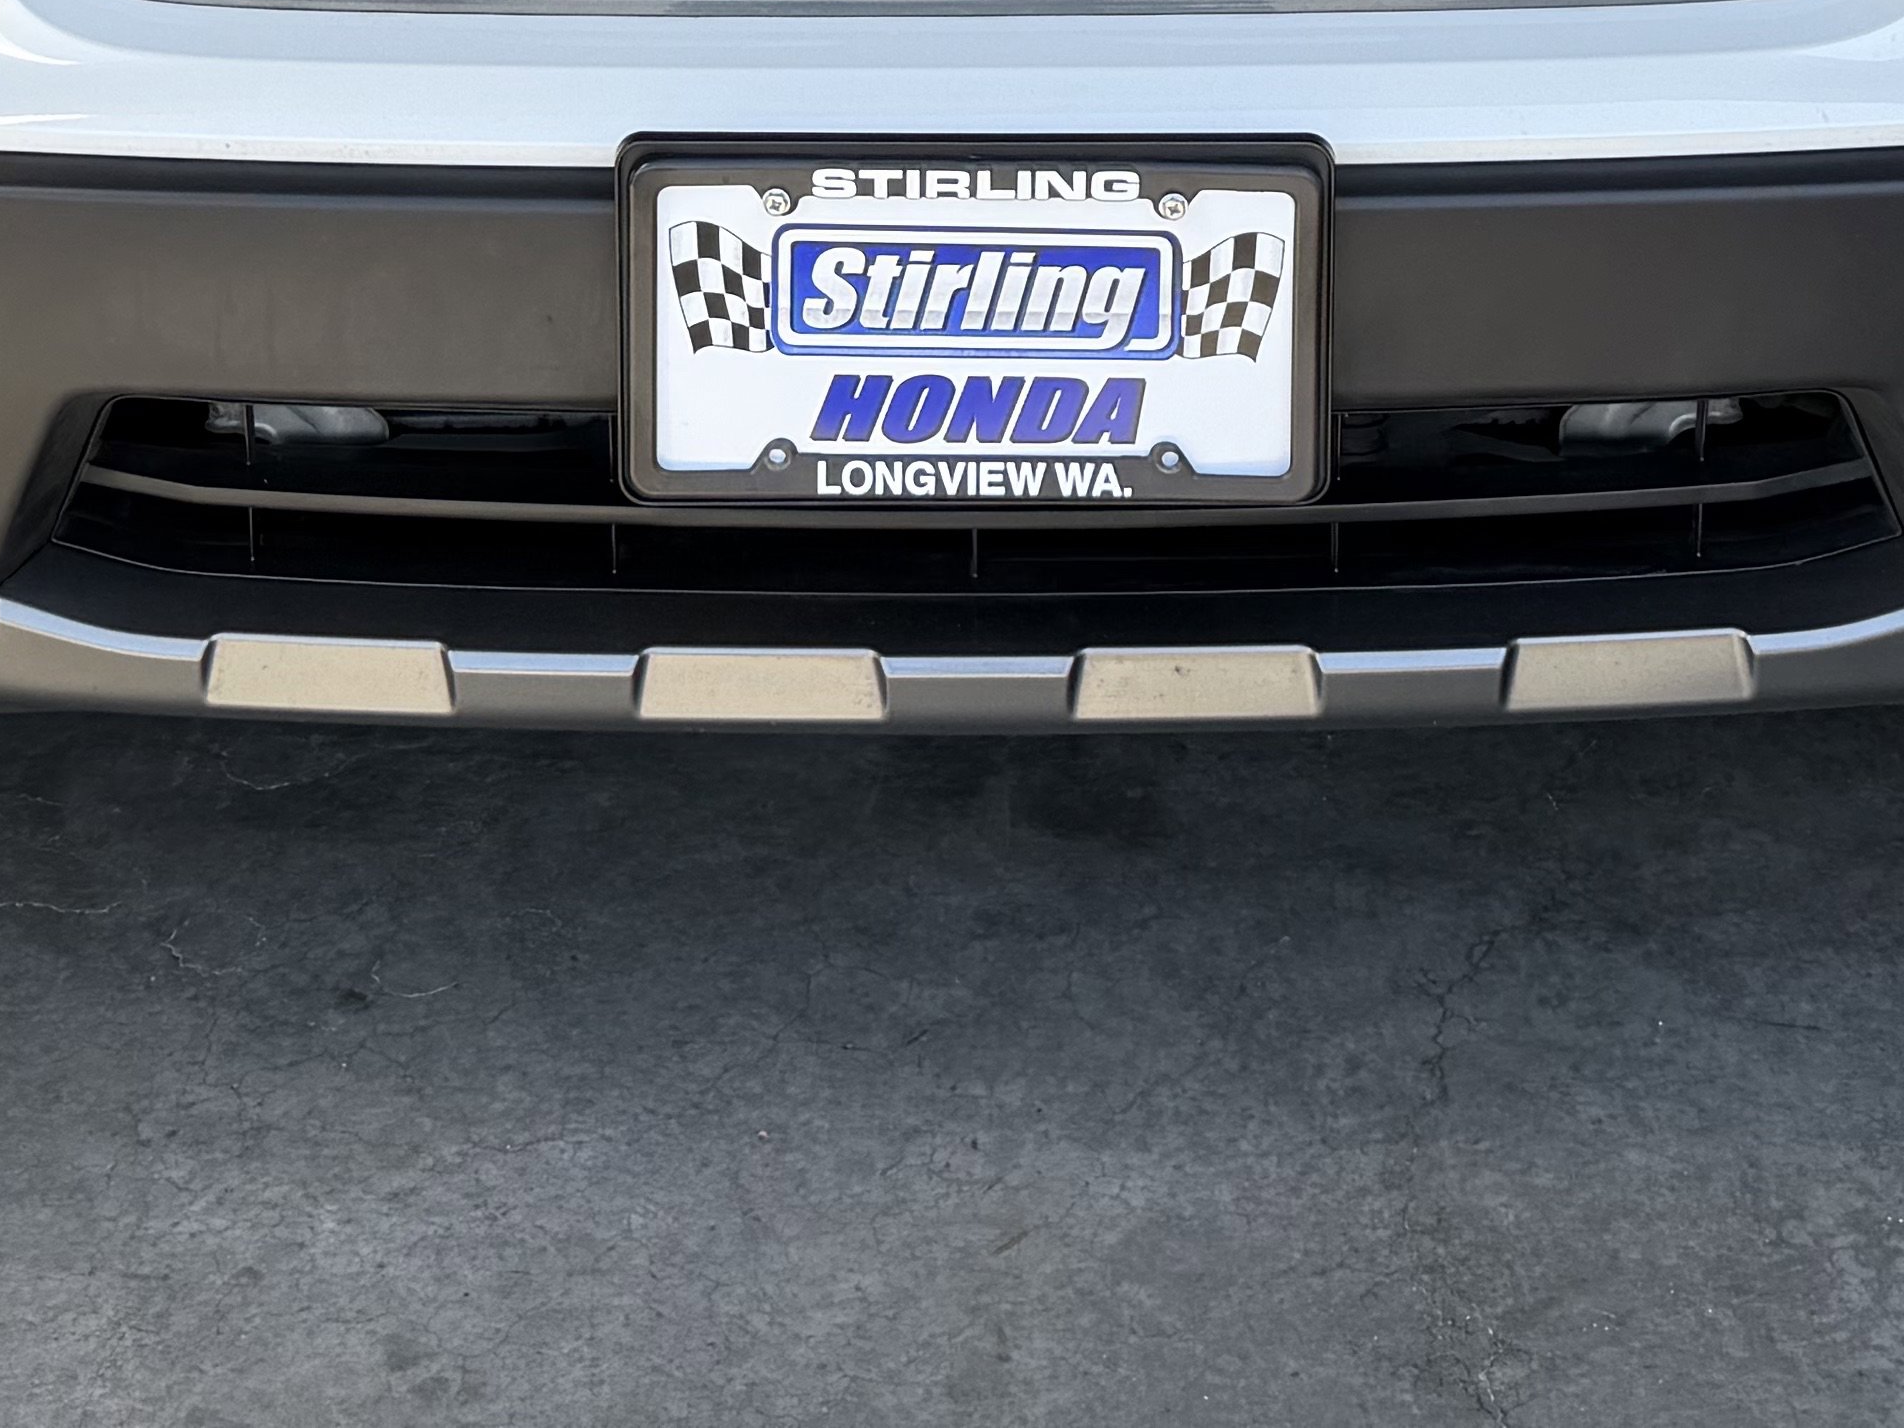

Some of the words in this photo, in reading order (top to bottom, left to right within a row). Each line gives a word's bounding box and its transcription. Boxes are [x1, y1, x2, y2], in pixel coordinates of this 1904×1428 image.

[811, 168, 1141, 202] STIRLING
[800, 246, 1148, 351] Stirling
[809, 374, 1147, 445] HONDA
[816, 460, 1047, 496] LONGVIEW
[1053, 461, 1133, 498] WA.
